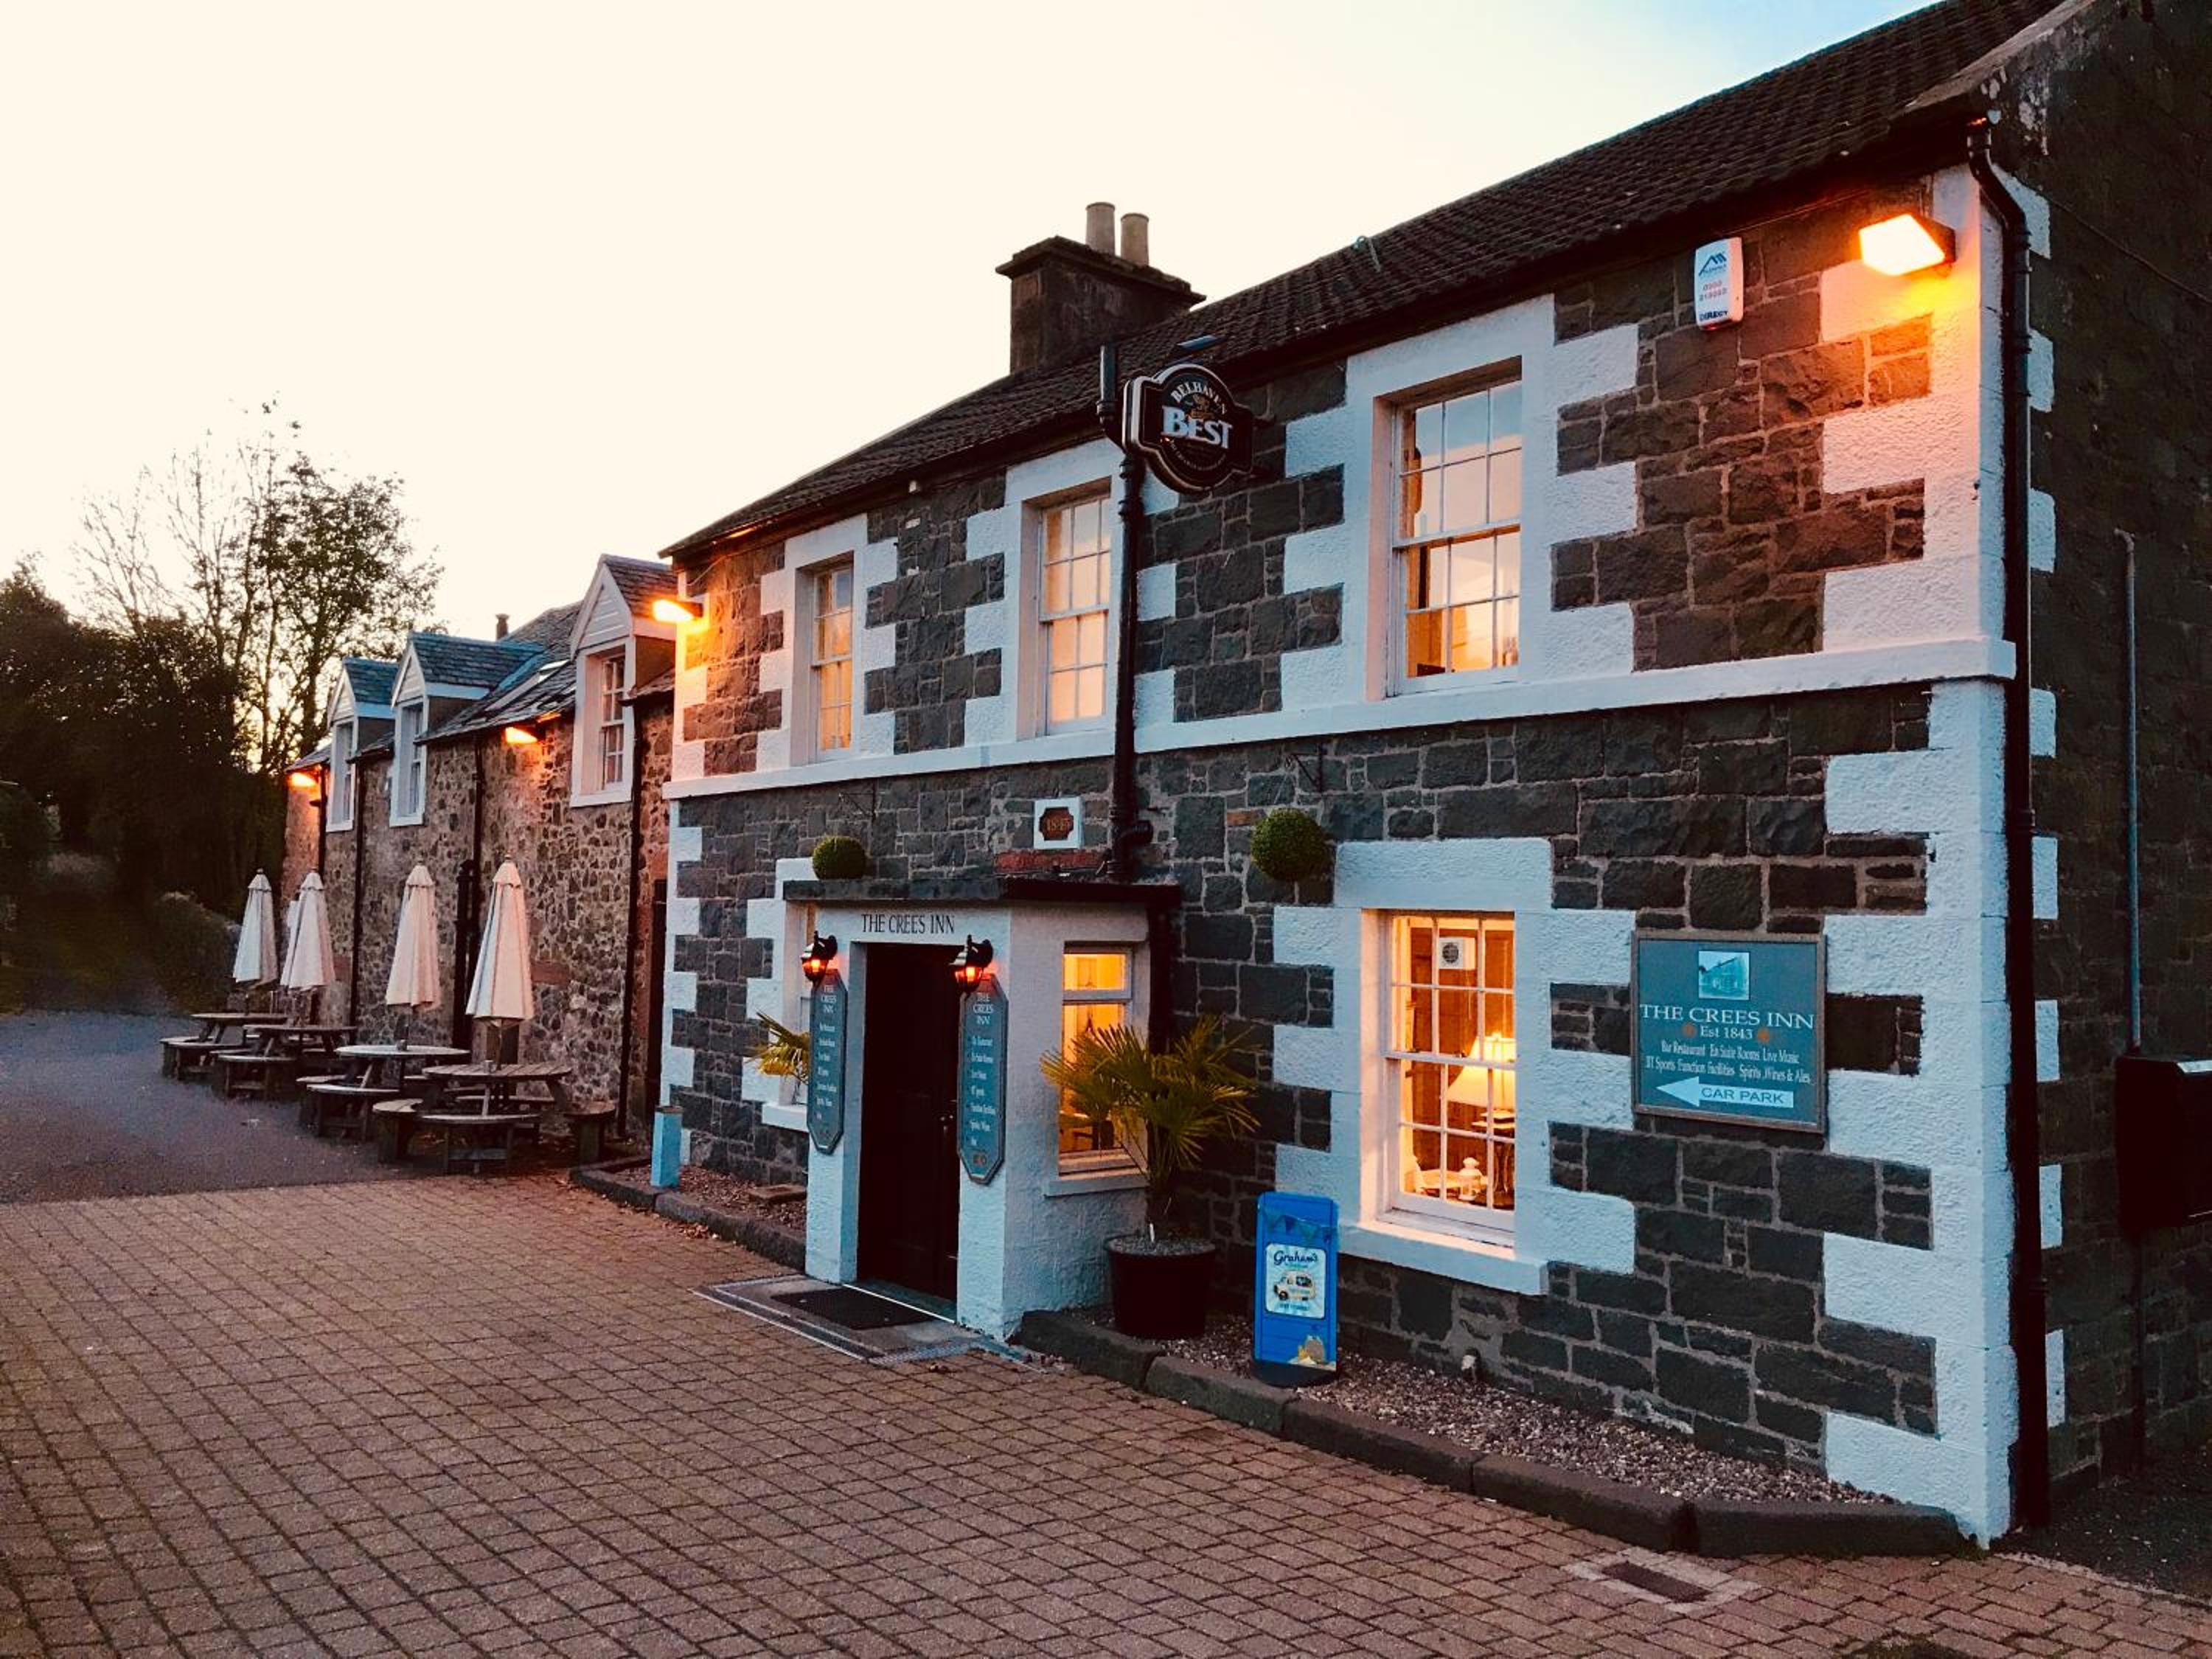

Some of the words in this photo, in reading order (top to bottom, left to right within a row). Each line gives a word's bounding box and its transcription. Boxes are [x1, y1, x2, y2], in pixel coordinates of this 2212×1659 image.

[1160, 405, 1233, 449] BEST
[861, 914, 886, 933] THE
[888, 914, 925, 934] CREES
[929, 914, 955, 934] INN
[1639, 1004, 1683, 1020] THE
[1688, 1007, 1760, 1026] CREES
[1767, 1012, 1815, 1030] INN
[1700, 1026, 1720, 1038] Est
[1724, 1027, 1753, 1040] 1843
[1737, 1046, 1760, 1060] Rooms
[1763, 1047, 1778, 1062] Live
[1779, 1049, 1800, 1064] Music
[1655, 1056, 1676, 1074] Sports
[1677, 1059, 1706, 1074] Function
[1701, 1087, 1735, 1100] CAR
[1740, 1089, 1784, 1105] PARK
